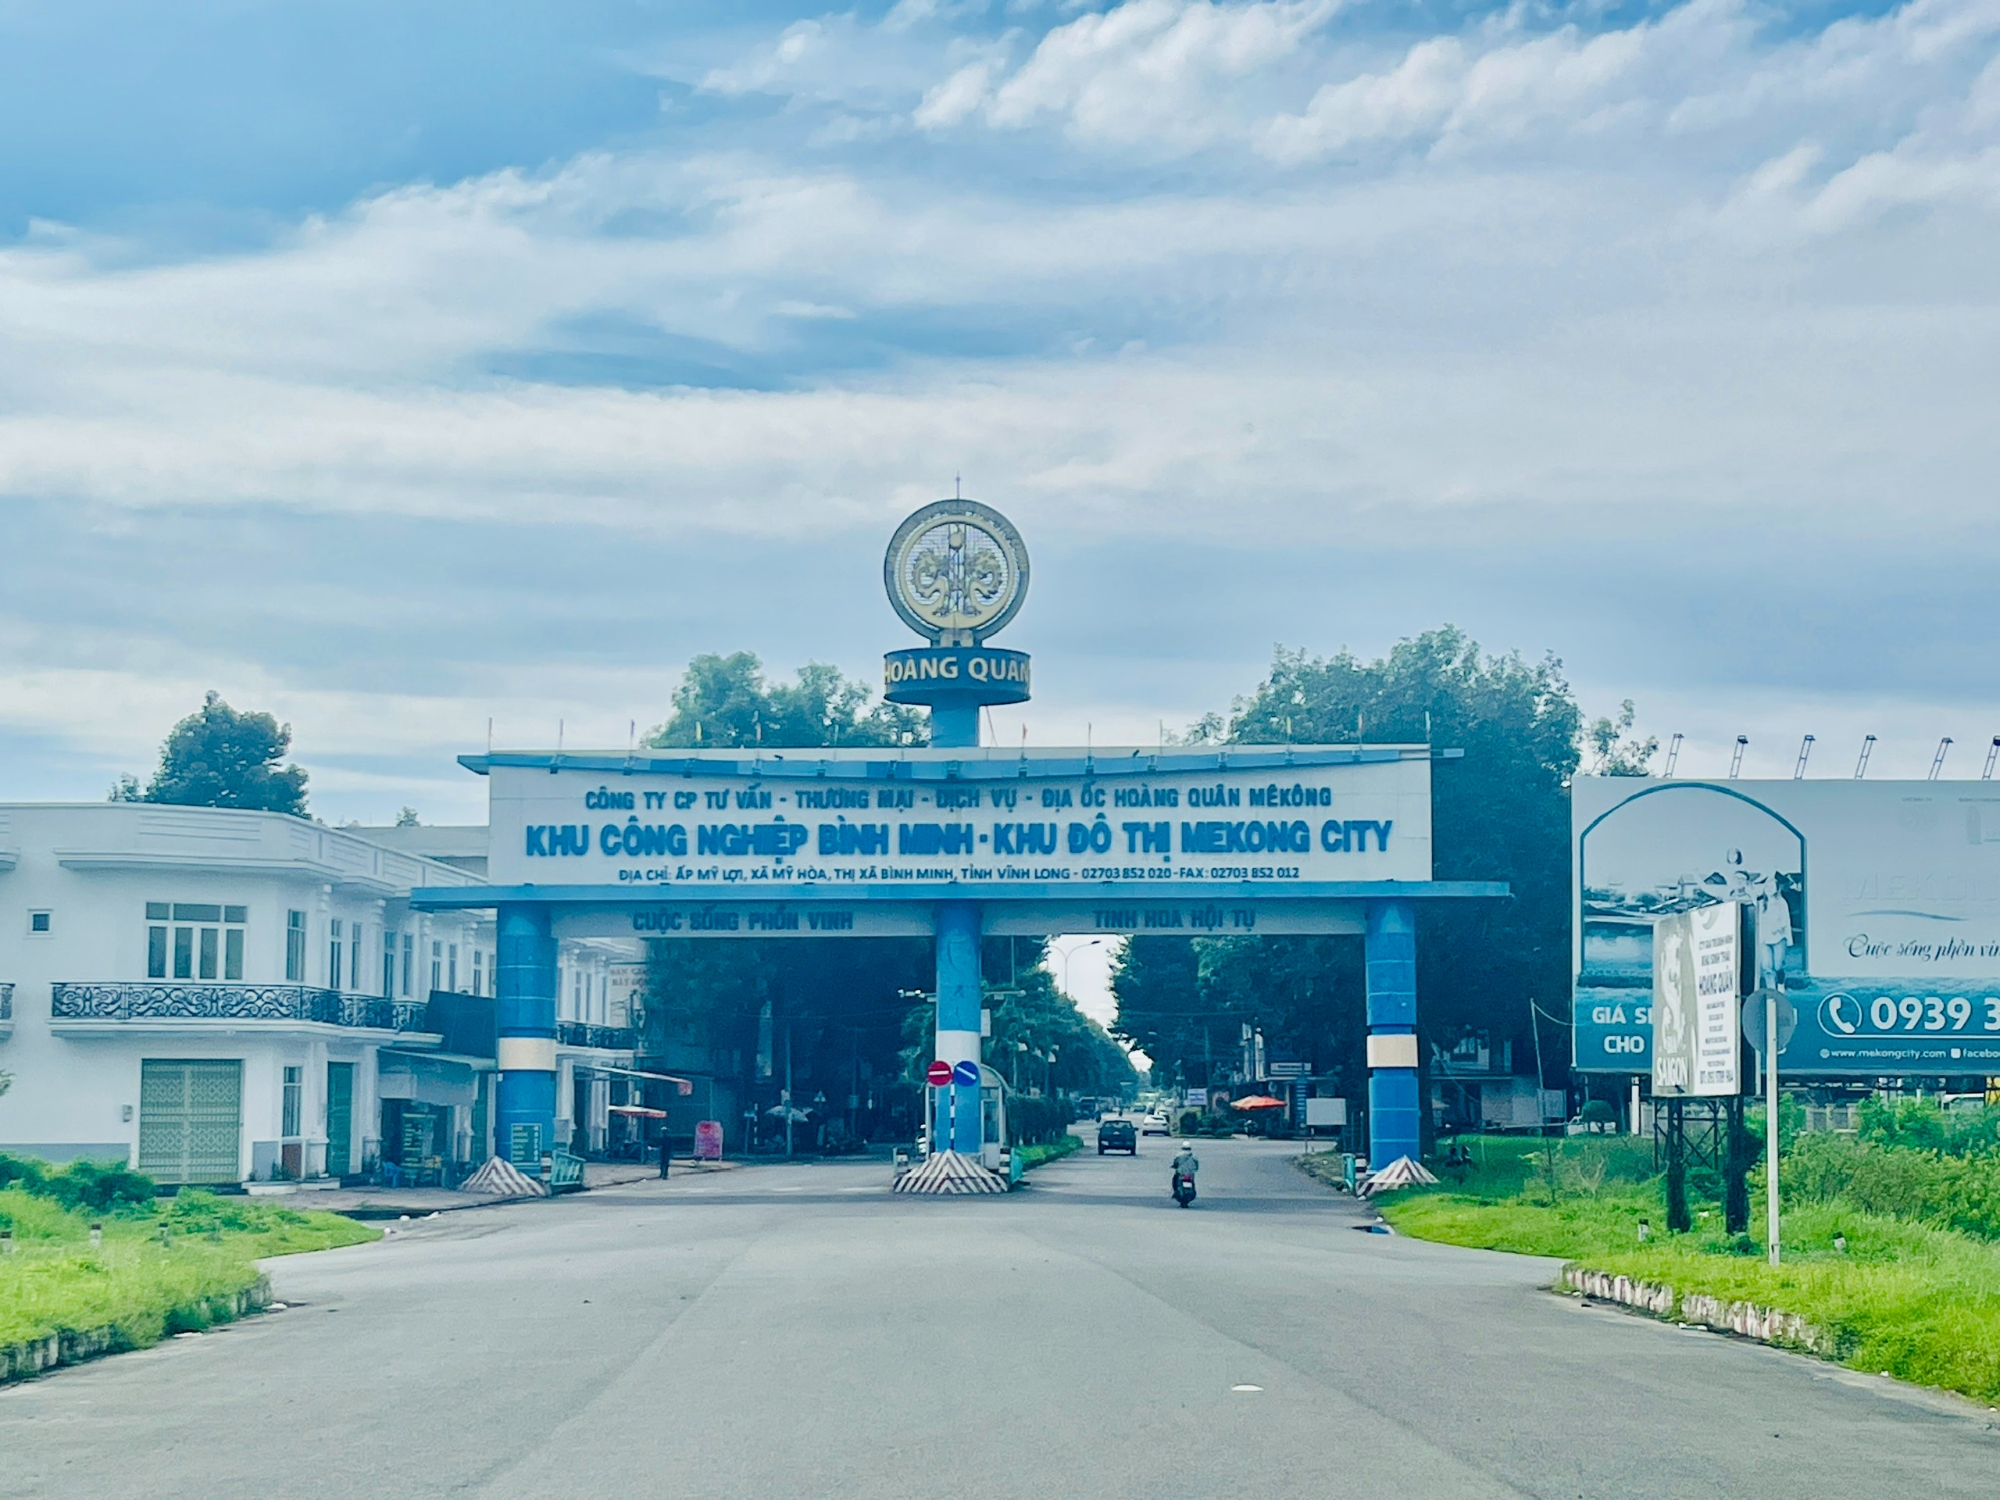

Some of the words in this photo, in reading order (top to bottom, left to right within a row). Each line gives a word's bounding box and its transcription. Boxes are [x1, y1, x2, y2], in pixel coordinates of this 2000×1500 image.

[585, 786, 635, 810] CÔNG
[643, 791, 667, 810] TY
[674, 791, 698, 810] CP
[704, 788, 730, 810] TƯ
[735, 782, 772, 810] VẤN
[991, 788, 1018, 813] VỤ
[1114, 783, 1179, 808] HOÀNG
[1187, 783, 1240, 807] QUÂN
[1249, 783, 1332, 807] MÊKÔNG
[526, 824, 590, 857] KHU
[600, 814, 688, 857] CÔNG
[697, 814, 808, 865] NGHIỆP
[818, 814, 889, 856] BÌNH
[899, 822, 974, 855] MINH
[993, 821, 1058, 855] KHU
[1067, 812, 1112, 855] ĐÔ
[1122, 821, 1171, 863] THỊ
[1181, 819, 1311, 854] MEKONG
[1320, 819, 1393, 853] CITY
[618, 869, 643, 884] ĐỊA
[675, 865, 694, 881] ẤP
[697, 865, 719, 881] MỸ
[751, 866, 769, 880] XÃ
[772, 866, 794, 880] MỸ
[797, 865, 832, 882] HÒA,
[834, 868, 856, 883] THỊ
[859, 865, 877, 880] XÃ
[881, 865, 913, 880] BÌNH
[916, 868, 958, 882] MINH,
[997, 865, 1030, 879] VĨNH
[1034, 867, 1071, 880] LONG
[1081, 867, 1120, 879] 02703
[1122, 867, 1145, 879] 852
[1211, 867, 1249, 879] 02703
[1251, 867, 1274, 879] 852
[1277, 867, 1300, 879] 012
[807, 911, 854, 931] VINH
[1144, 909, 1184, 929] HOA
[1592, 1002, 1627, 1025] GIÁ
[1870, 996, 1971, 1031] 0939
[1603, 1035, 1645, 1054] CHO
[1831, 1048, 1947, 1060] www.mekongcity.com
